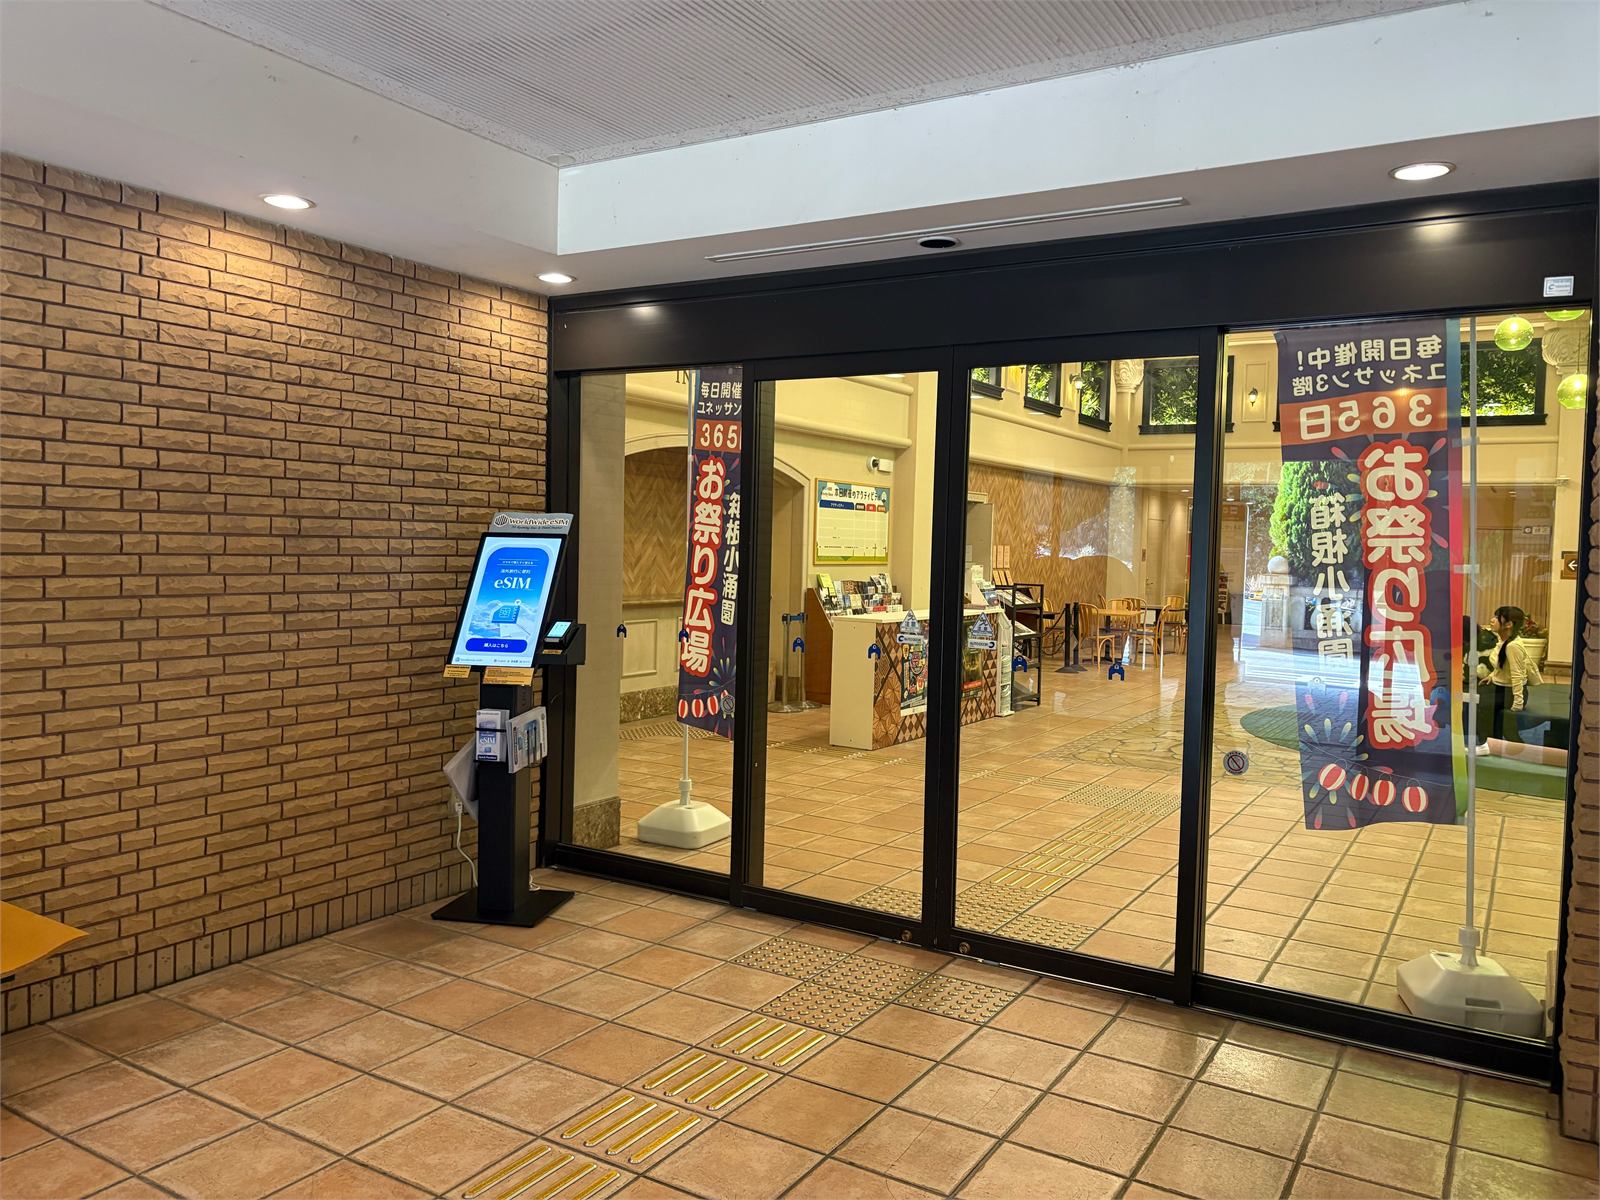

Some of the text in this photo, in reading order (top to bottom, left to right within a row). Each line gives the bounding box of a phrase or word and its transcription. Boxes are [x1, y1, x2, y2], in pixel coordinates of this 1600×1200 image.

[701, 381, 742, 399] 毎日開催
[697, 401, 742, 416] ユネッサン
[700, 423, 741, 450] 365
[681, 460, 724, 673] お祭り広場
[494, 576, 531, 590] eSIM
